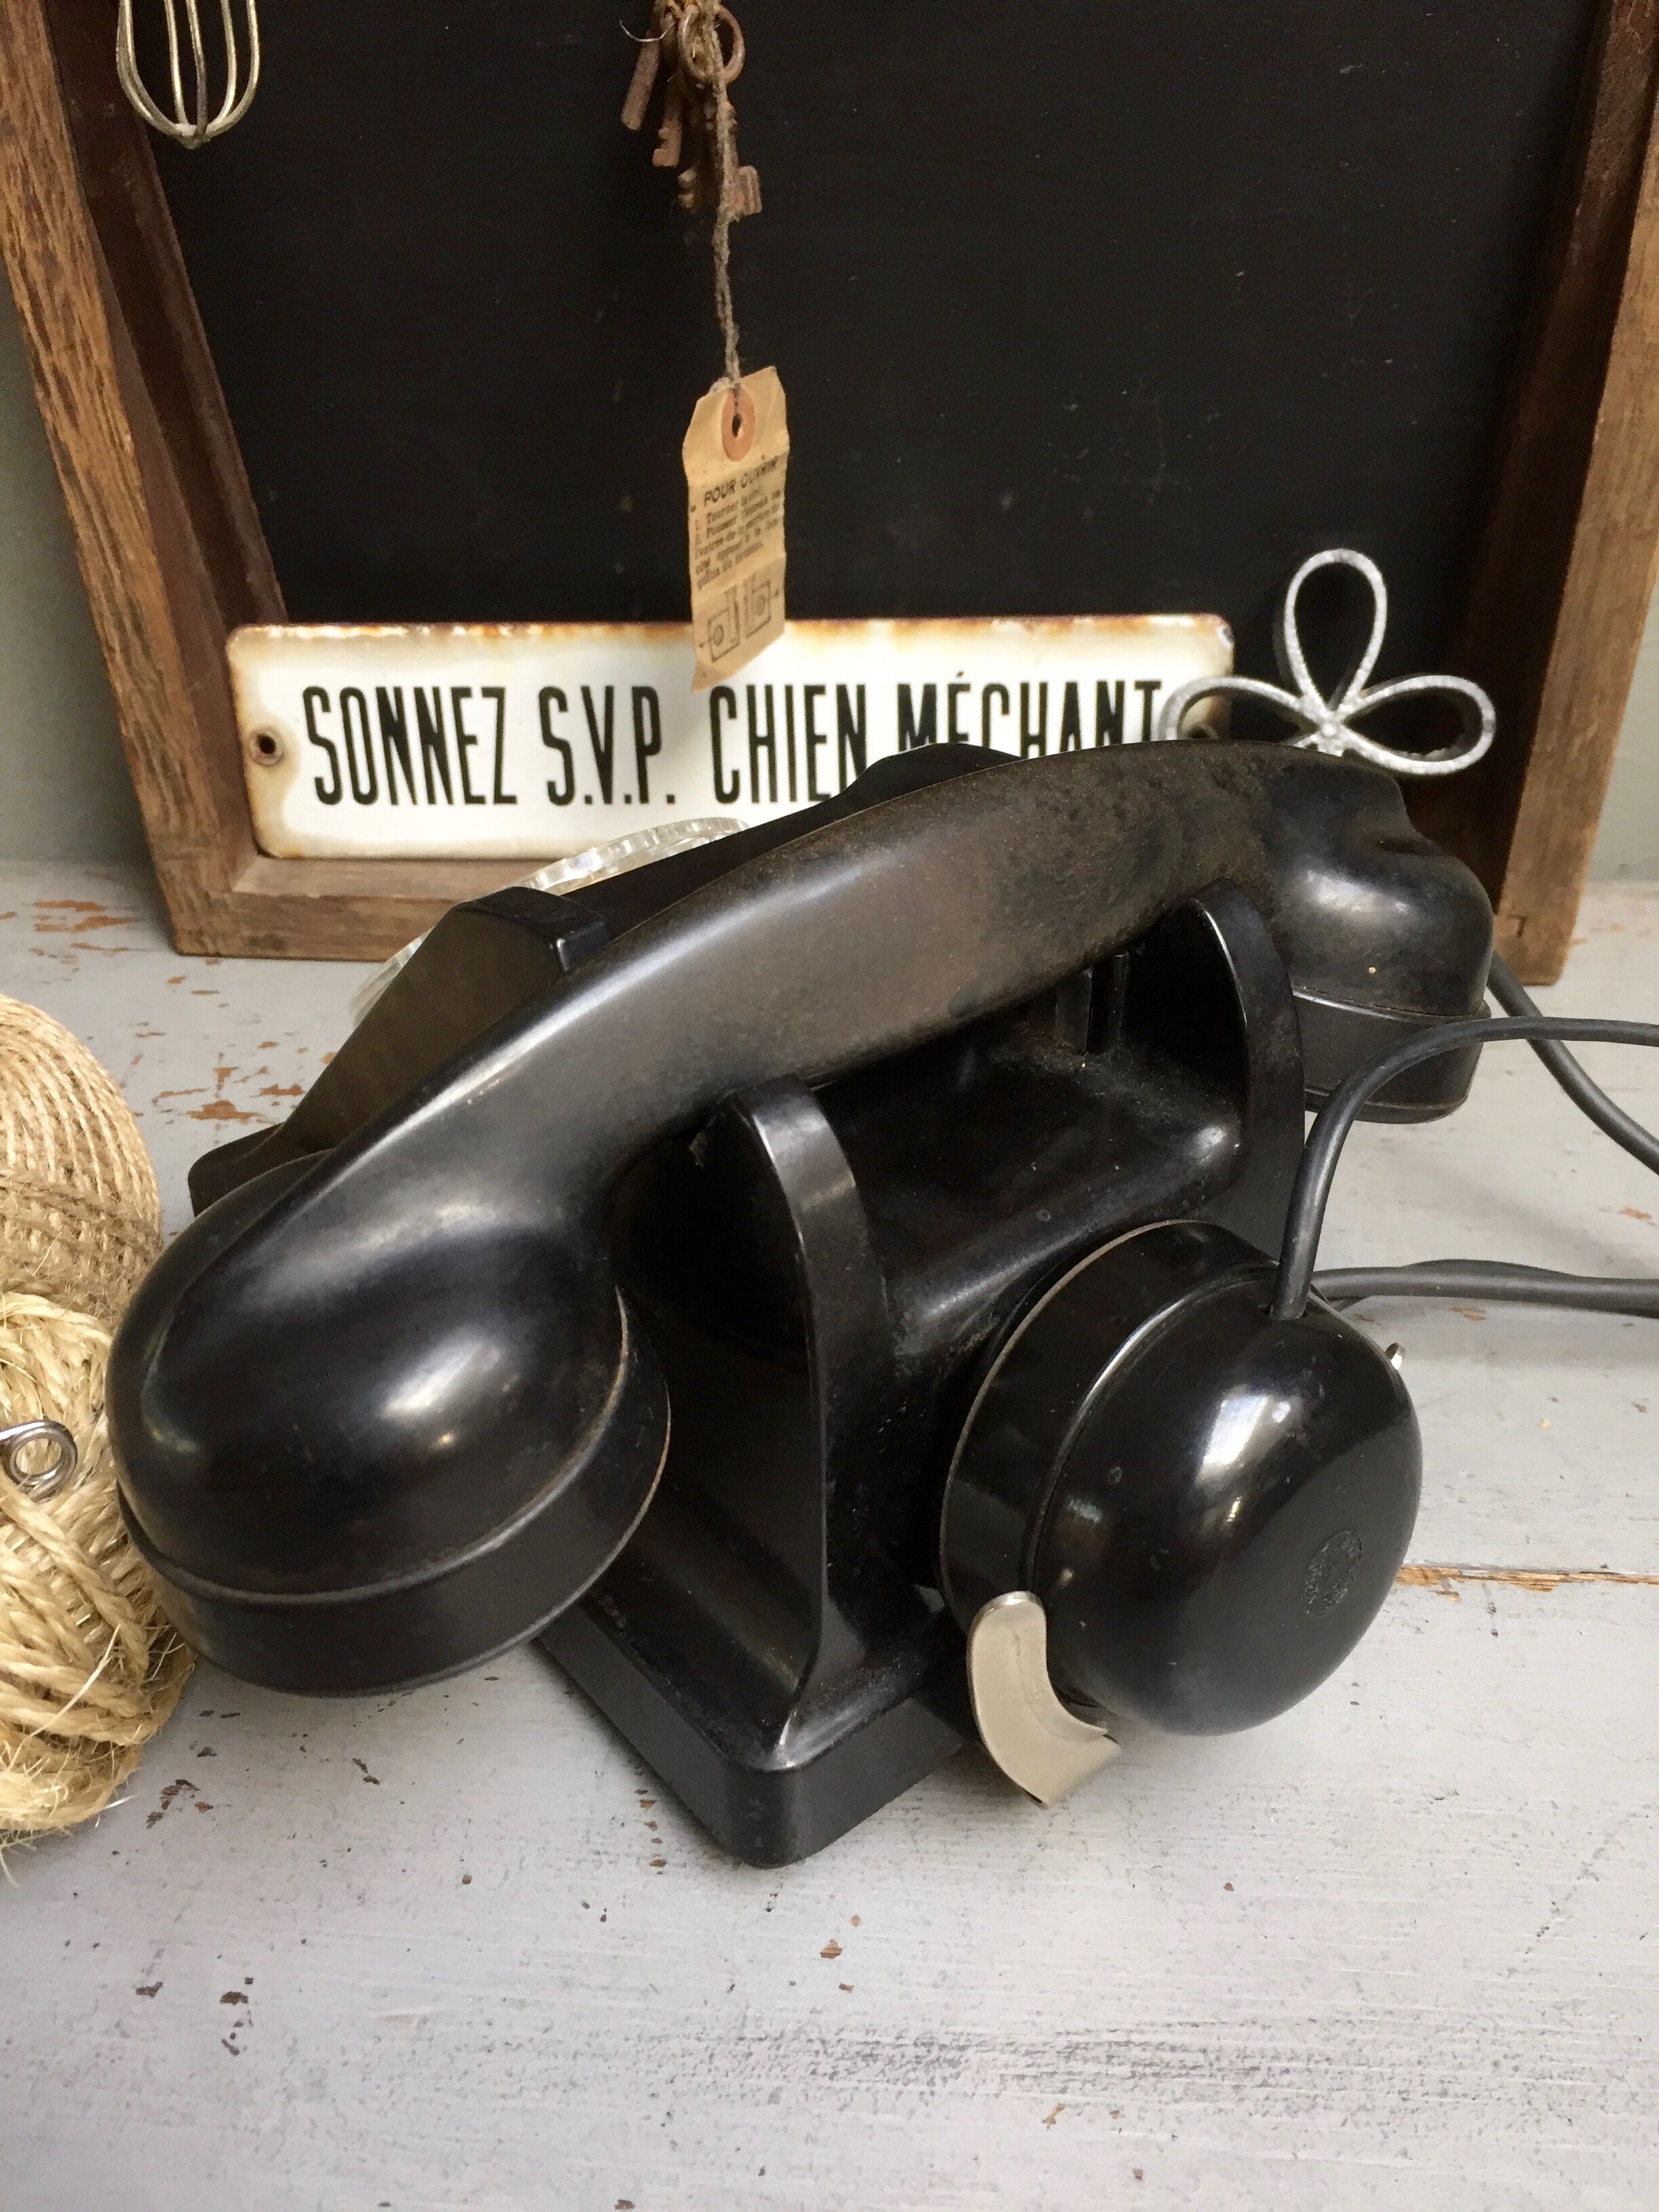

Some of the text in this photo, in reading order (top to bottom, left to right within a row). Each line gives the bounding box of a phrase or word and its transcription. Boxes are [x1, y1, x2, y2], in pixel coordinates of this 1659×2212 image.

[704, 477, 737, 507] POUR
[303, 686, 517, 805] SONNEZ
[539, 685, 676, 806] S.V.P.
[710, 684, 866, 804] CHIEN
